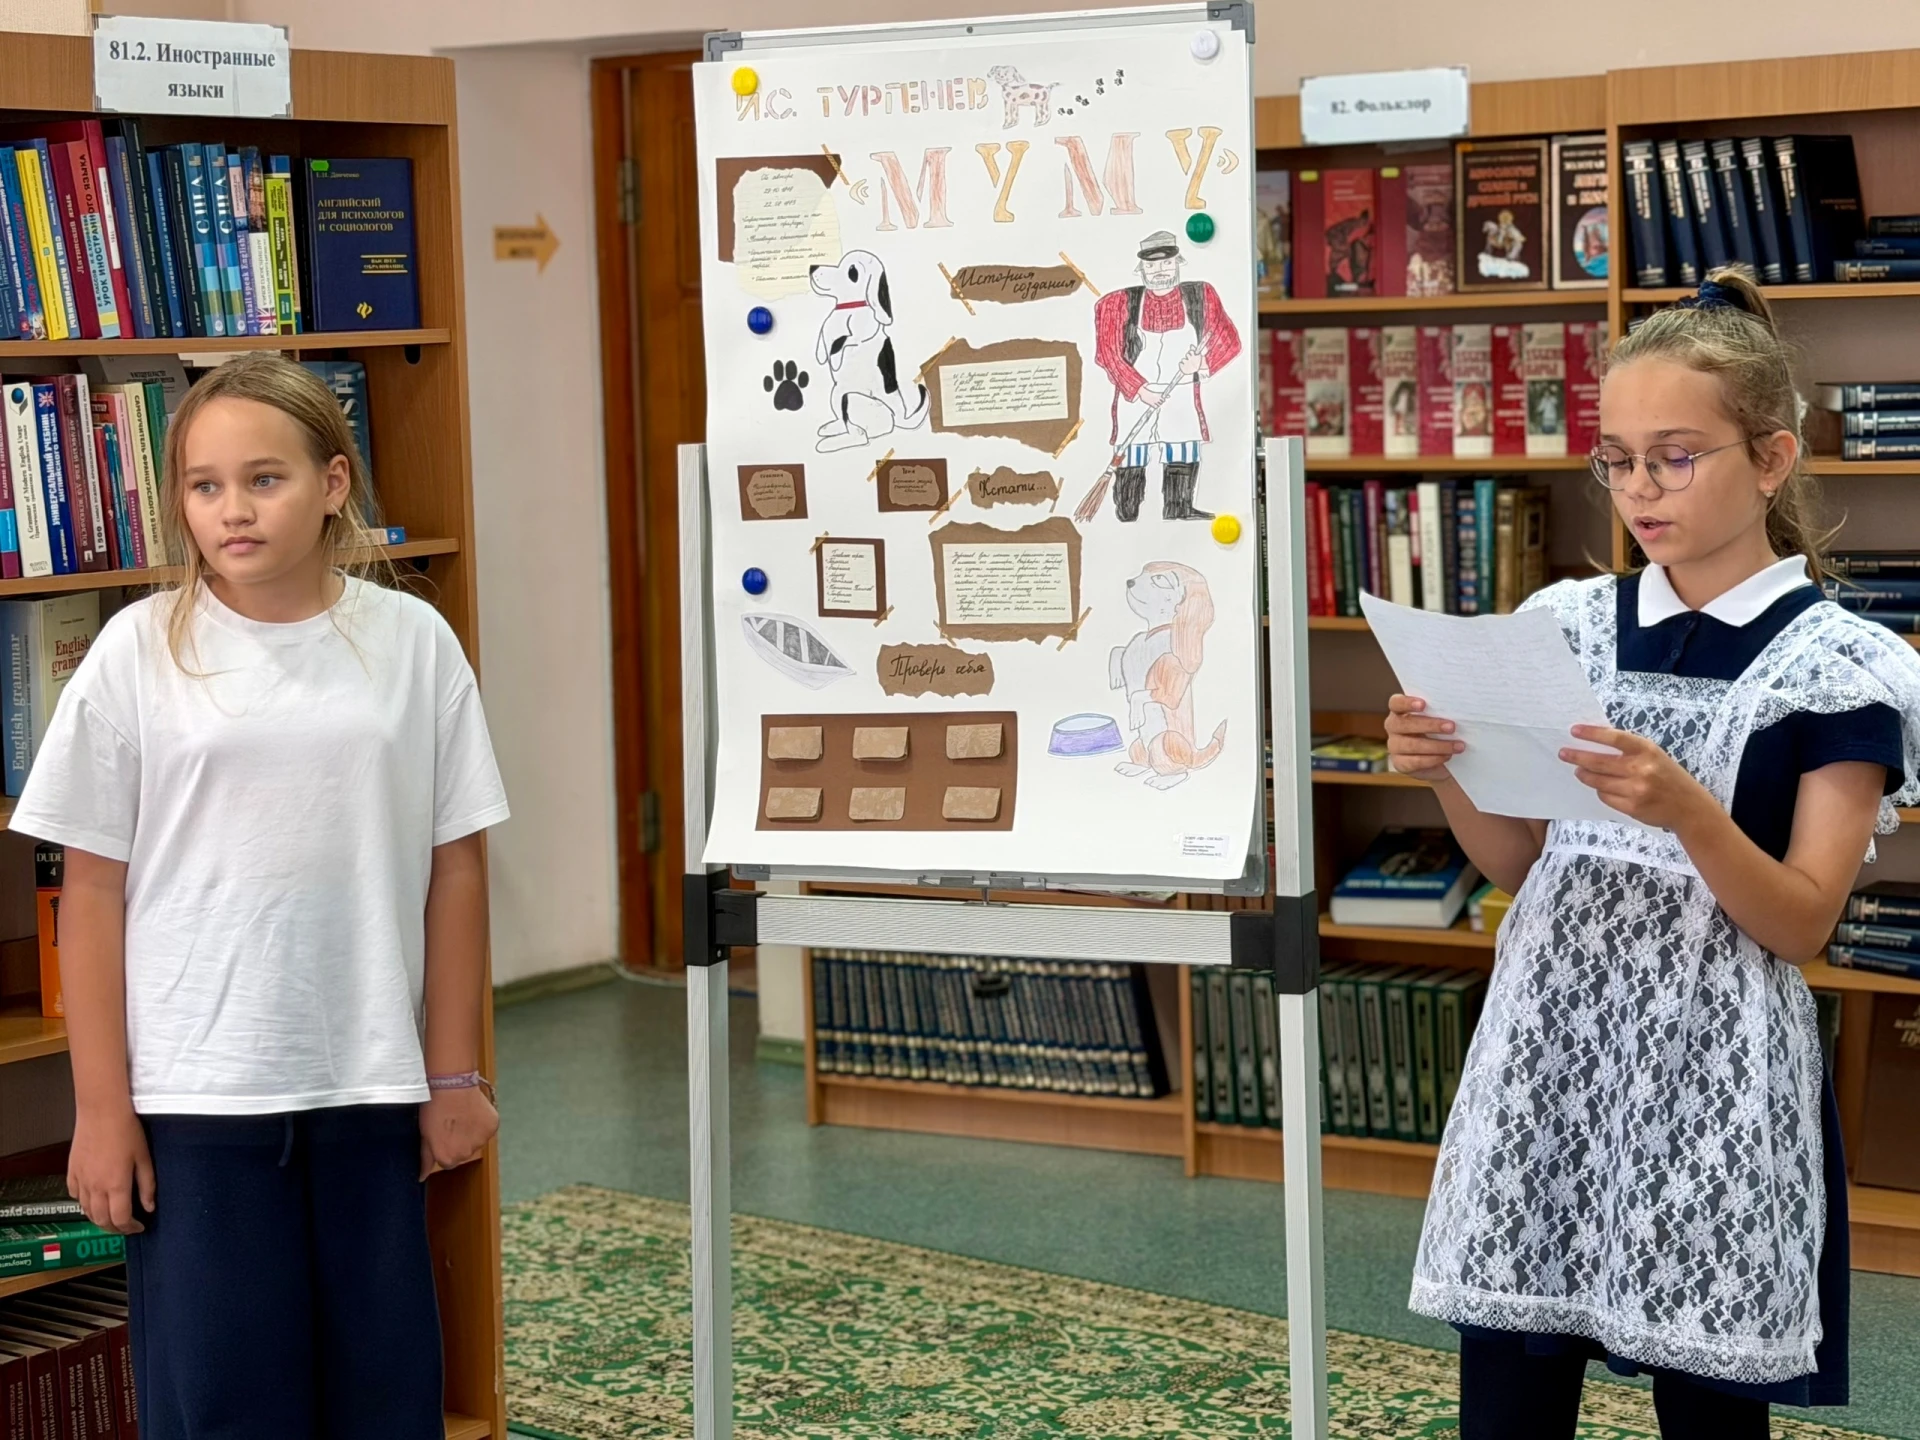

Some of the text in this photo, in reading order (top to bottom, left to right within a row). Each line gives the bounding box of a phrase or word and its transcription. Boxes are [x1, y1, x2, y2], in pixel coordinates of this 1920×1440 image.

[109, 40, 276, 69] 81.2. Иностранные
[167, 82, 225, 100] языки
[817, 77, 989, 117] ТУРГЕНЕВ
[1330, 97, 1432, 115] 82. Фольклор
[196, 173, 210, 235] США
[216, 173, 231, 235] США
[317, 197, 381, 207] АНГЛИЙСКИЙ
[318, 210, 405, 220] ДЛЯ ПСИХОЛОГОВ
[318, 222, 394, 232] И СОЦИОЛОГОВ
[64, 193, 85, 274] Латинский язык
[78, 153, 111, 306] УРОК ИНОСТРАННОГО ЯЗЫКА
[235, 232, 250, 270] English!
[53, 234, 64, 256] США
[59, 266, 76, 328] АМЕРИКАНЦЫ
[241, 270, 253, 295] speak
[959, 267, 1036, 292] История
[1013, 275, 1077, 299] создания
[243, 296, 254, 318] shall
[14, 424, 24, 443] Usage
[17, 444, 27, 468] English
[49, 411, 65, 502] АНГЛИЙСКОГО ЯЗЫКА
[133, 394, 147, 453] САМОУЧИТЕЛЬ
[140, 453, 156, 516] ФРАНЦУЗСКОГО
[20, 469, 29, 494] Modern
[40, 412, 60, 526] УНИВЕРСАЛЬНЫЙ УЧЕБНИК
[979, 478, 1047, 498] Кстати...
[24, 503, 34, 533] Grammar
[55, 633, 90, 657] English
[889, 653, 986, 685] Проверь себя
[10, 633, 26, 770] English grammar
[36, 852, 64, 862] DUDE
[50, 867, 57, 876] 4
[90, 1355, 104, 1434] БОЛЬШАЯ СОВЕТСКАЯ
